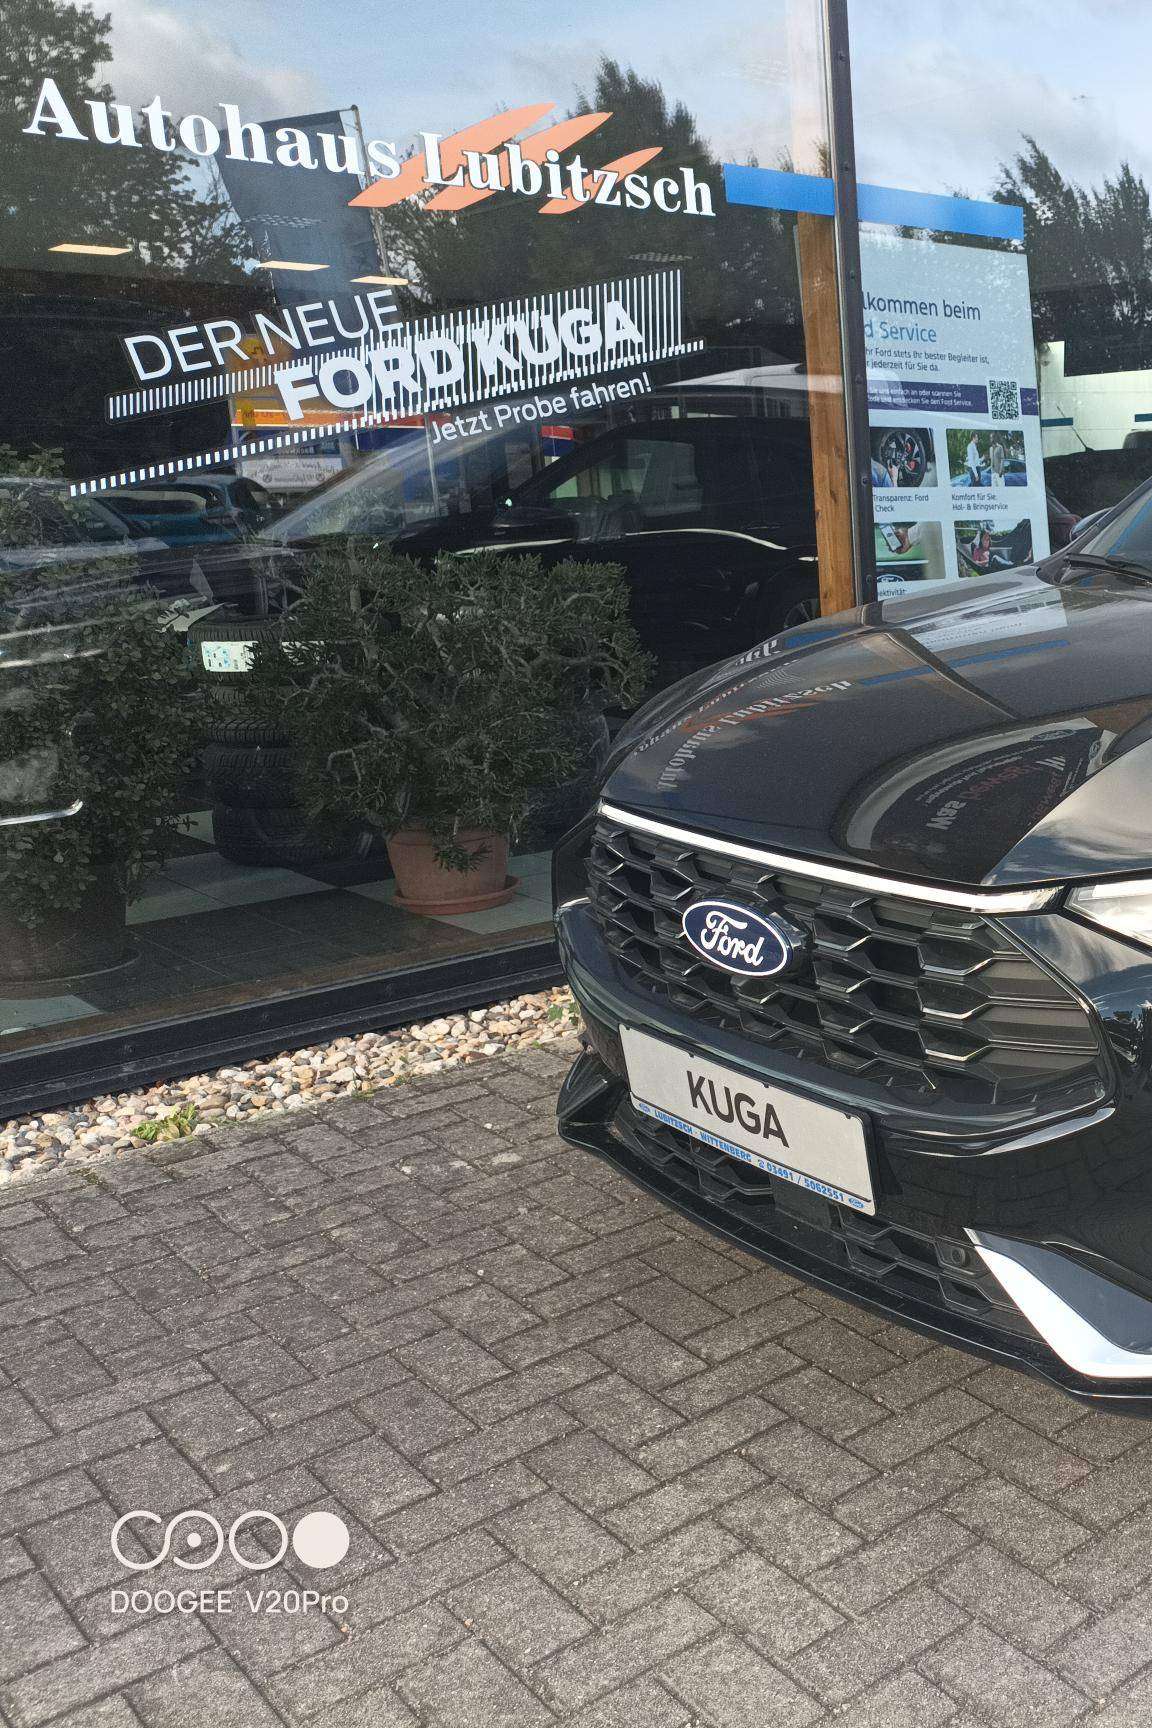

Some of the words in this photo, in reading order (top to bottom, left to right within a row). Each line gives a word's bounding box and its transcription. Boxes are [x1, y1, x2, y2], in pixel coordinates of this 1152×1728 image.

[22, 77, 402, 180] Autohaus
[420, 130, 718, 218] Lubitzsch
[863, 292, 938, 317] kommen
[943, 299, 981, 321] beim
[123, 319, 246, 382] DER
[254, 288, 405, 356] NEUE
[879, 321, 937, 343] Service
[274, 333, 466, 421] FORD
[472, 299, 645, 378] KUGA
[871, 360, 903, 370] jederzeit
[905, 361, 916, 369] für
[917, 362, 928, 371] Sie
[875, 348, 892, 357] Ford
[893, 349, 911, 358] stets
[925, 352, 946, 361] bester
[948, 353, 978, 363] Begleiter
[431, 408, 489, 446] Jetzt
[494, 394, 568, 431] Probe
[569, 372, 653, 411] fahren!
[914, 494, 929, 502] Ford
[952, 494, 975, 502] Komfort
[976, 493, 986, 501] für
[973, 503, 1008, 513] Bringservice
[699, 909, 766, 966] Ford
[686, 1070, 790, 1148] KUGA
[654, 1110, 693, 1135] LUBITZSCH
[700, 1131, 752, 1162] WITTENBERG
[766, 1162, 794, 1182] 03491
